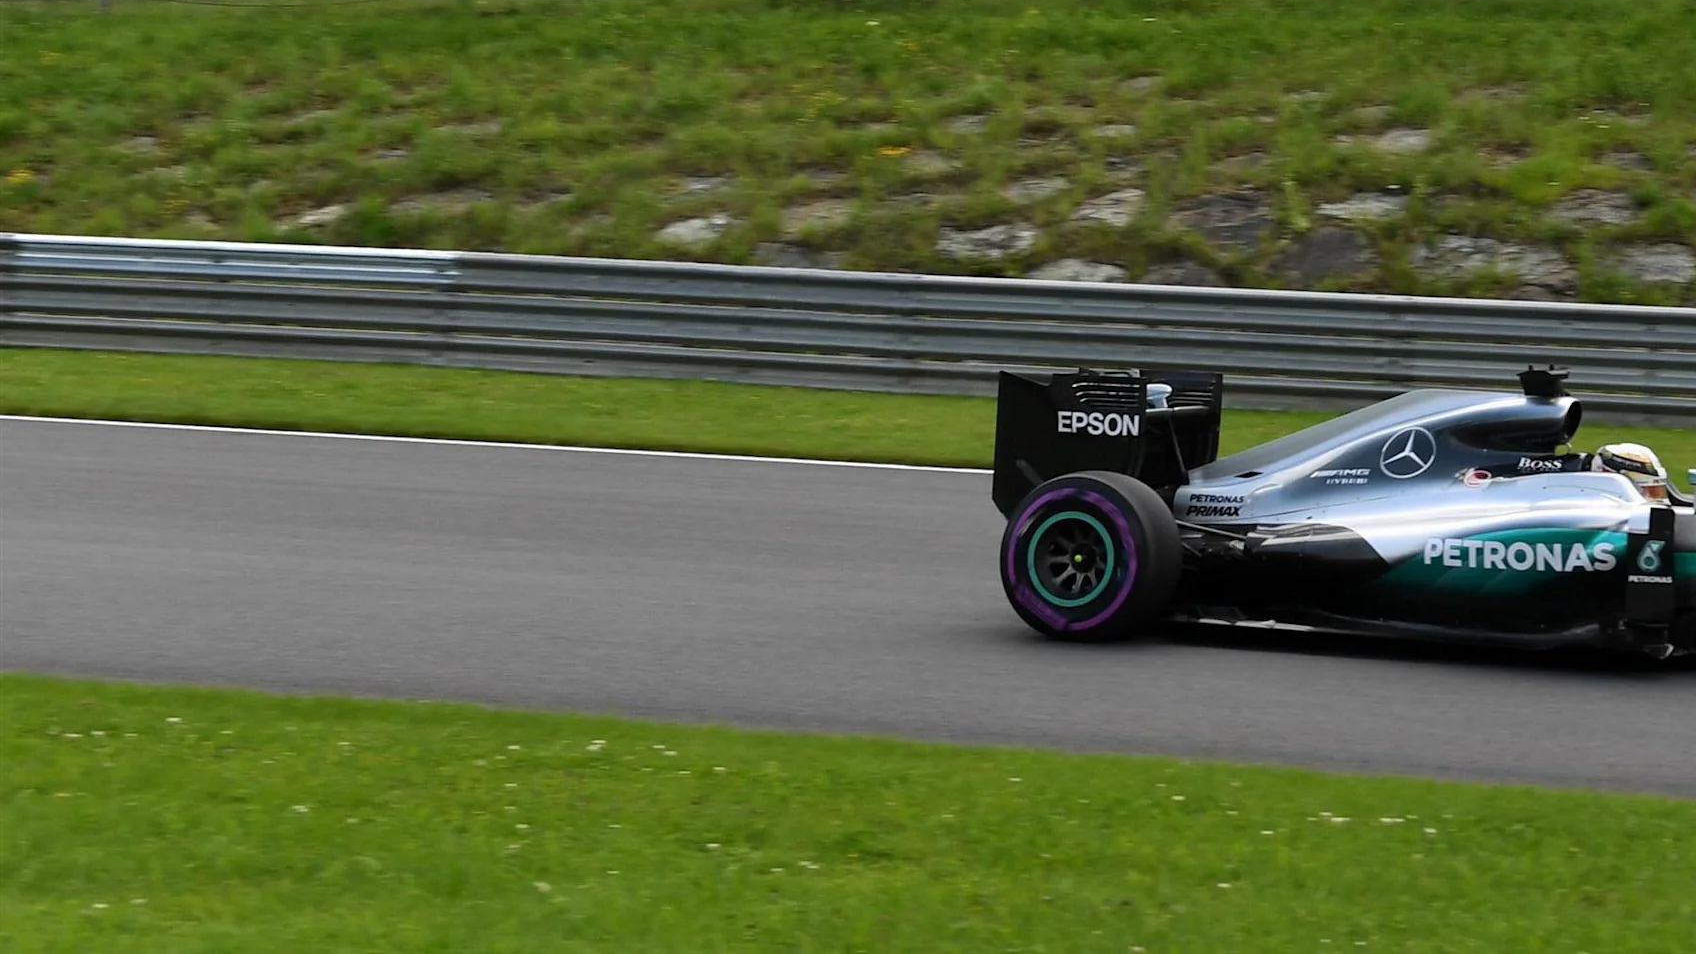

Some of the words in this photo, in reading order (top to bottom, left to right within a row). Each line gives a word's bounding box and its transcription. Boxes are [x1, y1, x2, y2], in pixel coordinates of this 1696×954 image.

[1057, 410, 1140, 437] EPSON
[1519, 457, 1562, 469] BOSS
[1189, 494, 1244, 503] PETRONAS
[1186, 505, 1242, 516] PRIMAX
[1424, 537, 1617, 573] PETRONAS
[1627, 575, 1672, 583] PETRONAS
